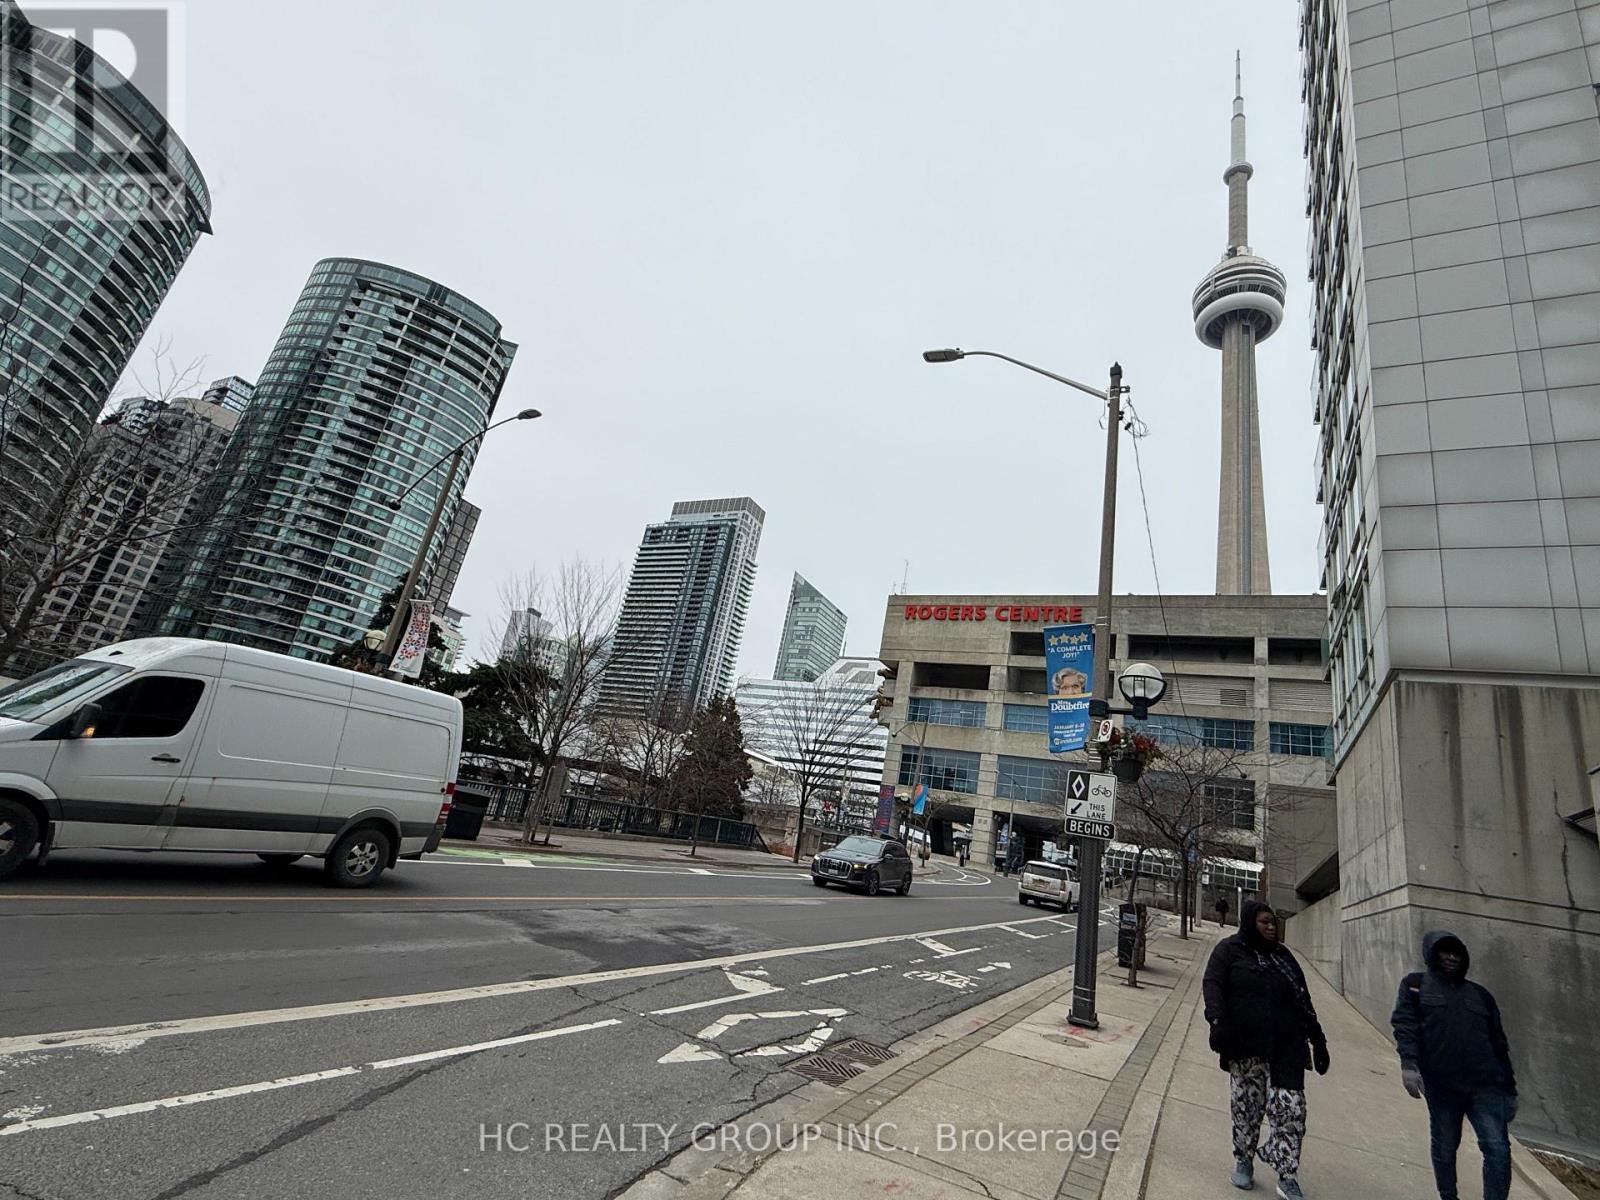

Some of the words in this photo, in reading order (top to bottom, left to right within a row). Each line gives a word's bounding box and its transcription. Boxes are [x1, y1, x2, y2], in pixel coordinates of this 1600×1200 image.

[904, 605, 987, 621] ROGERS
[994, 605, 1083, 622] CENTRE
[1056, 644, 1092, 653] COMPLETE
[1051, 701, 1089, 711] Doubtfire
[1089, 803, 1105, 812] THIS
[1086, 811, 1106, 820] LANE
[1070, 820, 1110, 837] BEGINS
